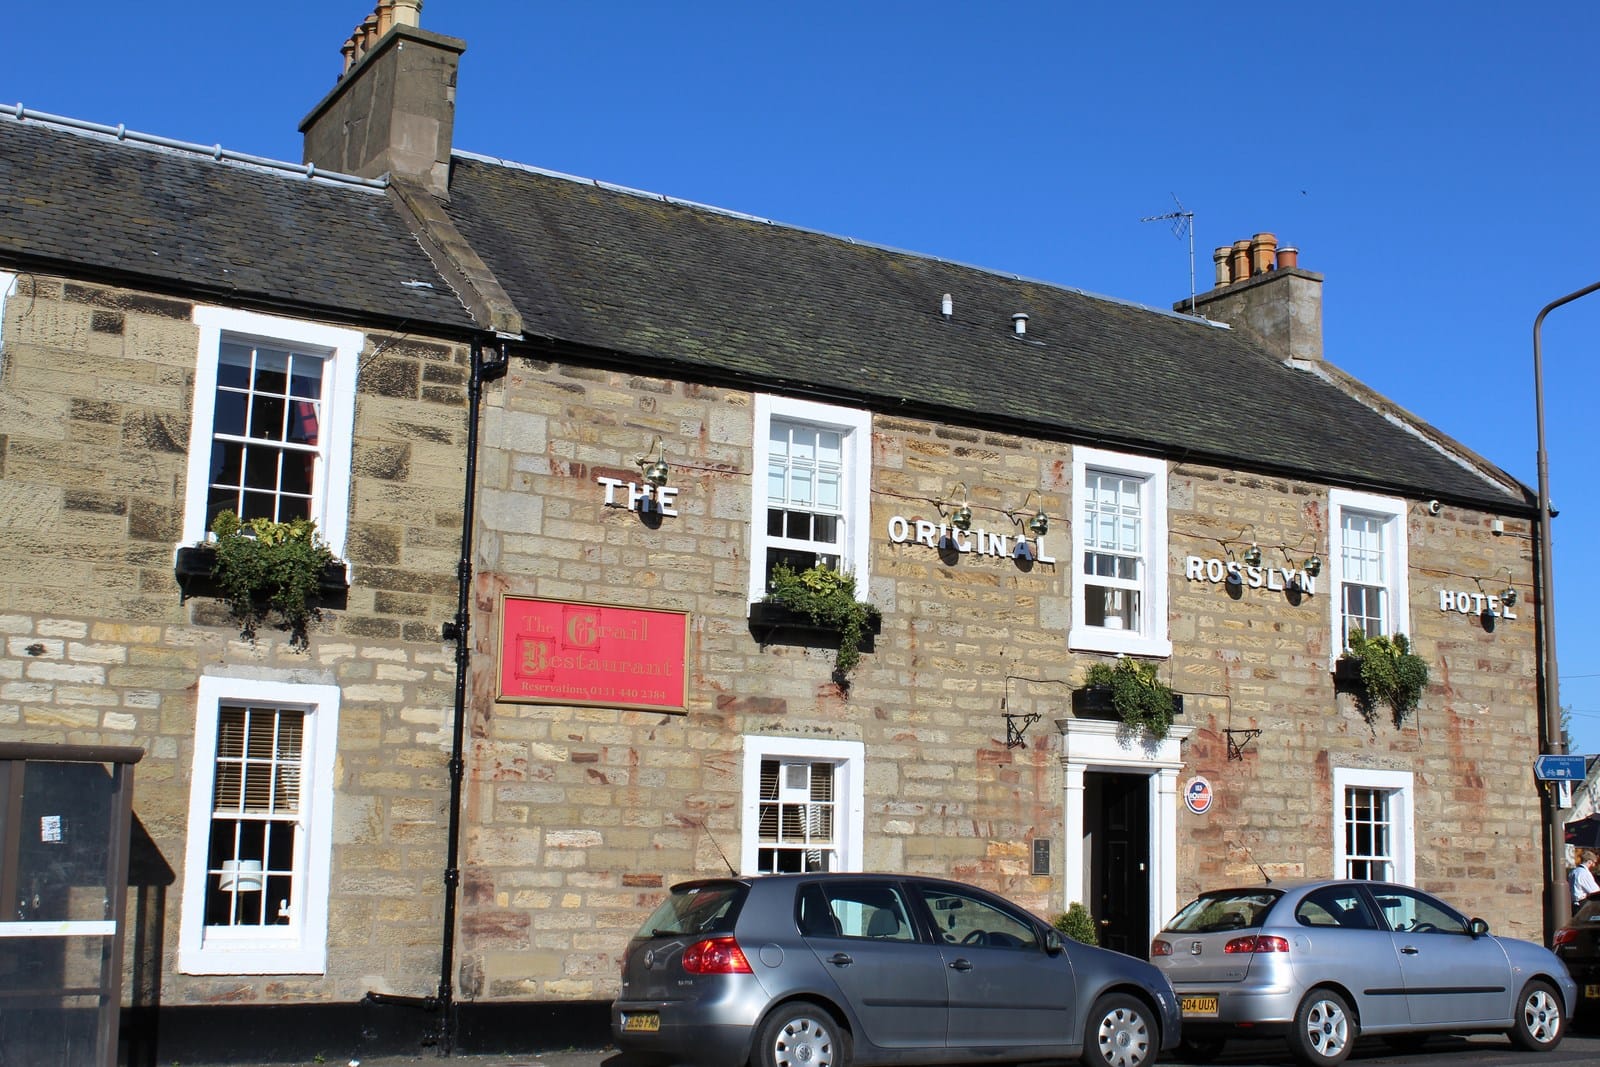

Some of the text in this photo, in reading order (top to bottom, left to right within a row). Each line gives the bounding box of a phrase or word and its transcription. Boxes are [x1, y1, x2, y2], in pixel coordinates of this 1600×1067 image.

[597, 476, 1517, 619] THE ORIGINAL ROSSLYN HOTEL
[522, 612, 648, 647] The Grail
[522, 640, 672, 676] Restaurant
[1198, 999, 1216, 1010] UUX
